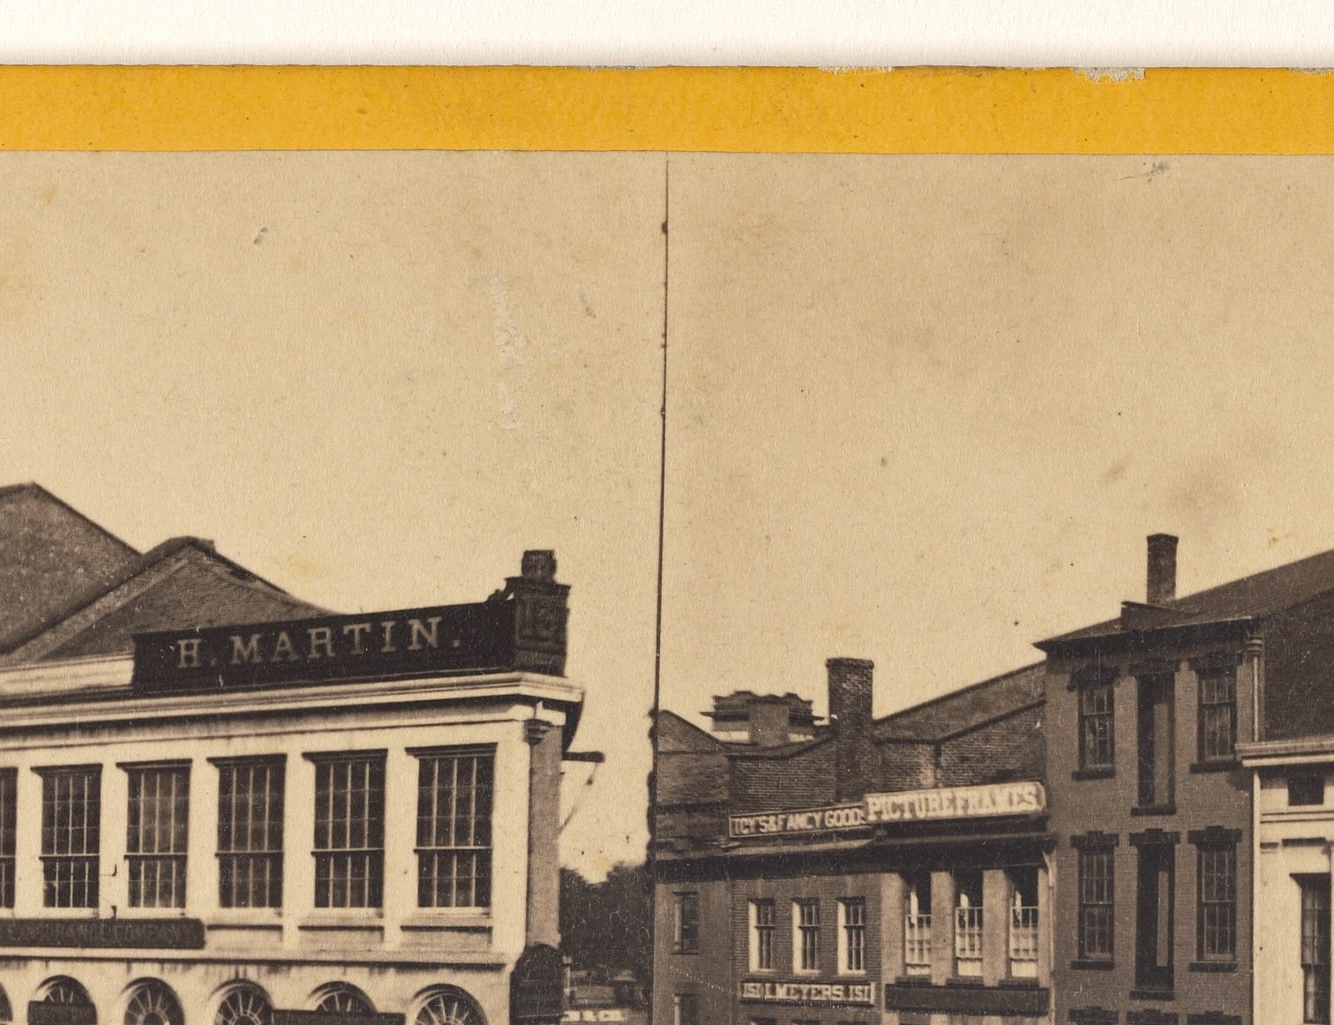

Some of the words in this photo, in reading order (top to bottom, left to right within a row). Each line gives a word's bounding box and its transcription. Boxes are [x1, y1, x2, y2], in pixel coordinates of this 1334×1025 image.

[177, 637, 218, 668] H.
[229, 616, 461, 665] MARTIN.
[777, 811, 822, 832] FANCY
[865, 791, 954, 822] PICTURE
[955, 784, 1038, 815] FRAMES
